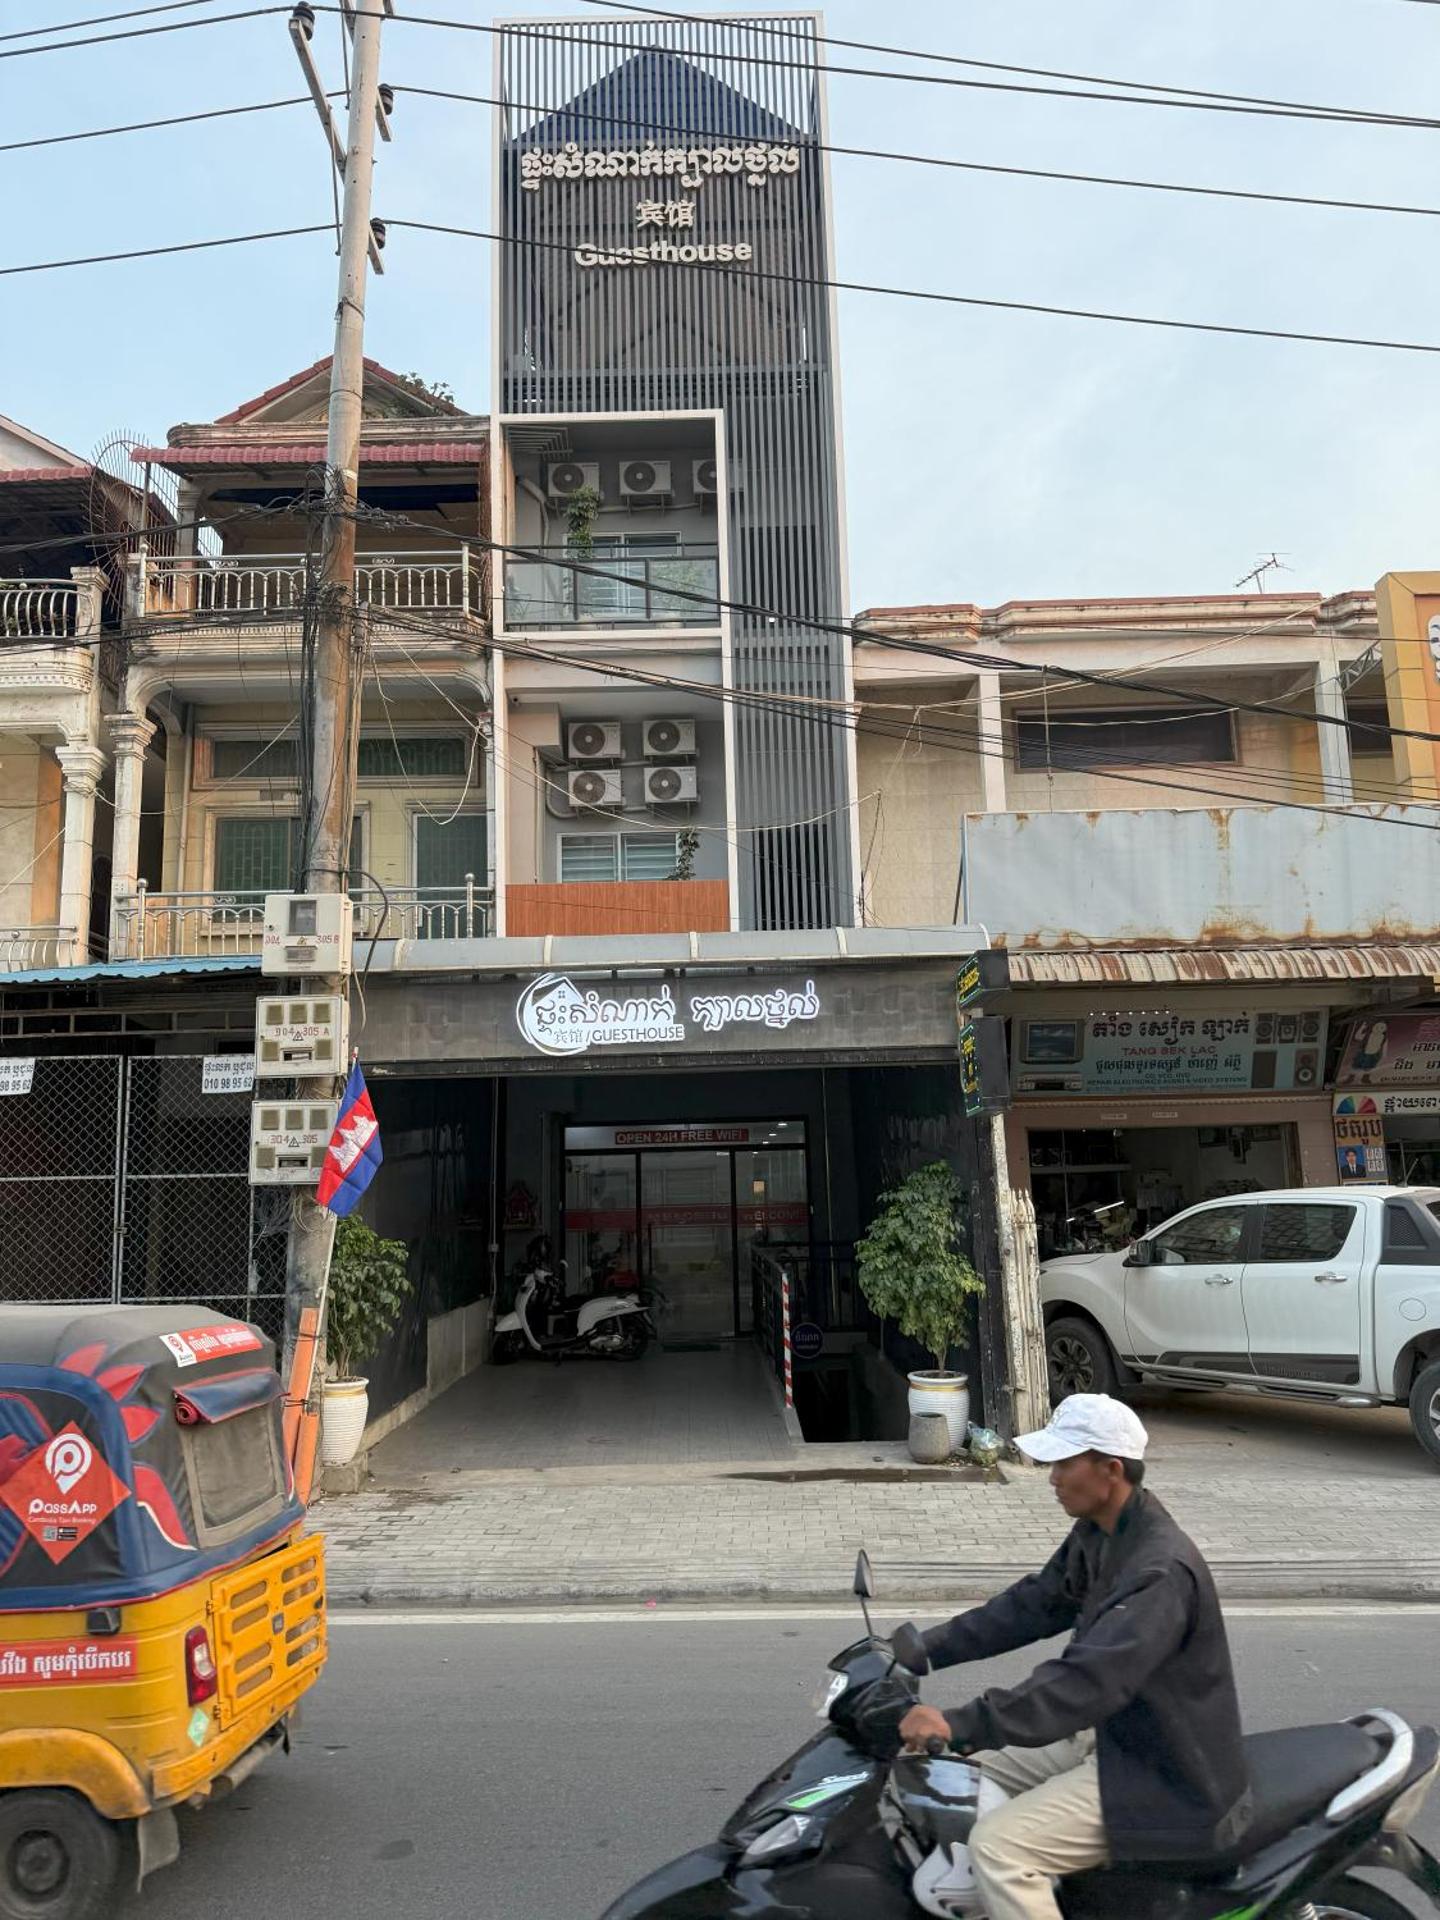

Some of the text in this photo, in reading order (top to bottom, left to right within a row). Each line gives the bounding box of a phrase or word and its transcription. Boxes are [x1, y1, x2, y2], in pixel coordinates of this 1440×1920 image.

[636, 199, 695, 228] 宾馆
[575, 240, 752, 267] Guesthouse
[554, 1027, 584, 1045] 宾馆
[592, 1026, 684, 1042] GUESTHOUSE
[1190, 1045, 1216, 1054] LAC
[204, 1076, 252, 1090] 010 98 95 62
[616, 1129, 742, 1144] OPEN 24H FREE WIFI
